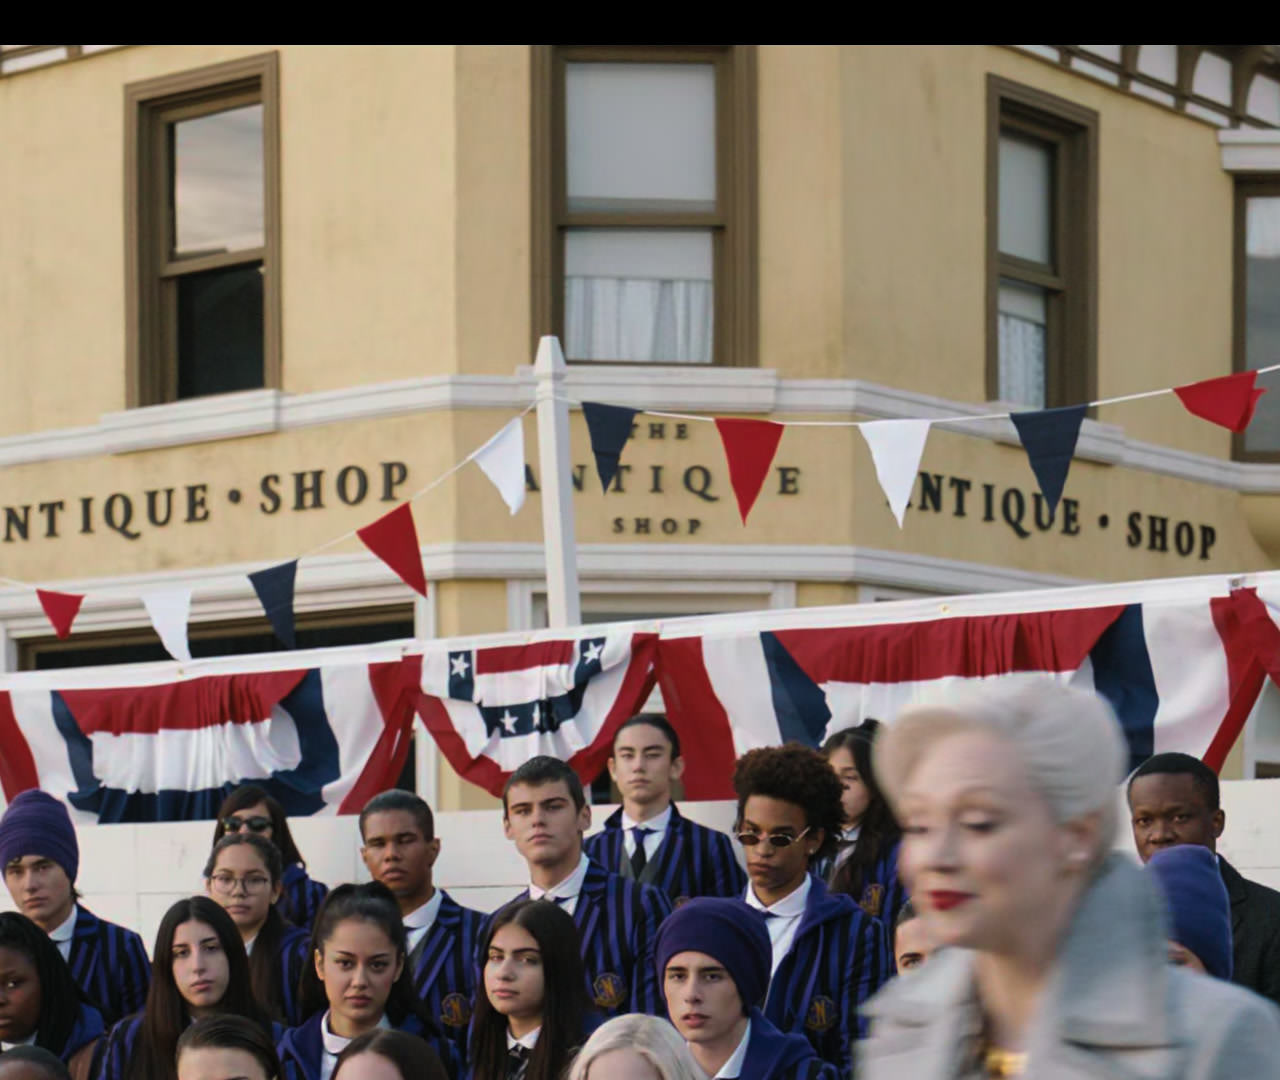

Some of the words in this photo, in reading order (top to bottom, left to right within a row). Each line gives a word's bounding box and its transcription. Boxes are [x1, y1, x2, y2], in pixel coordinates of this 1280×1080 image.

[260, 461, 409, 515] SHOP
[524, 463, 801, 502] ANTIQE
[612, 517, 702, 535] SHOP
[886, 471, 1081, 539] NTIQUE
[1126, 511, 1217, 560] SHOP
